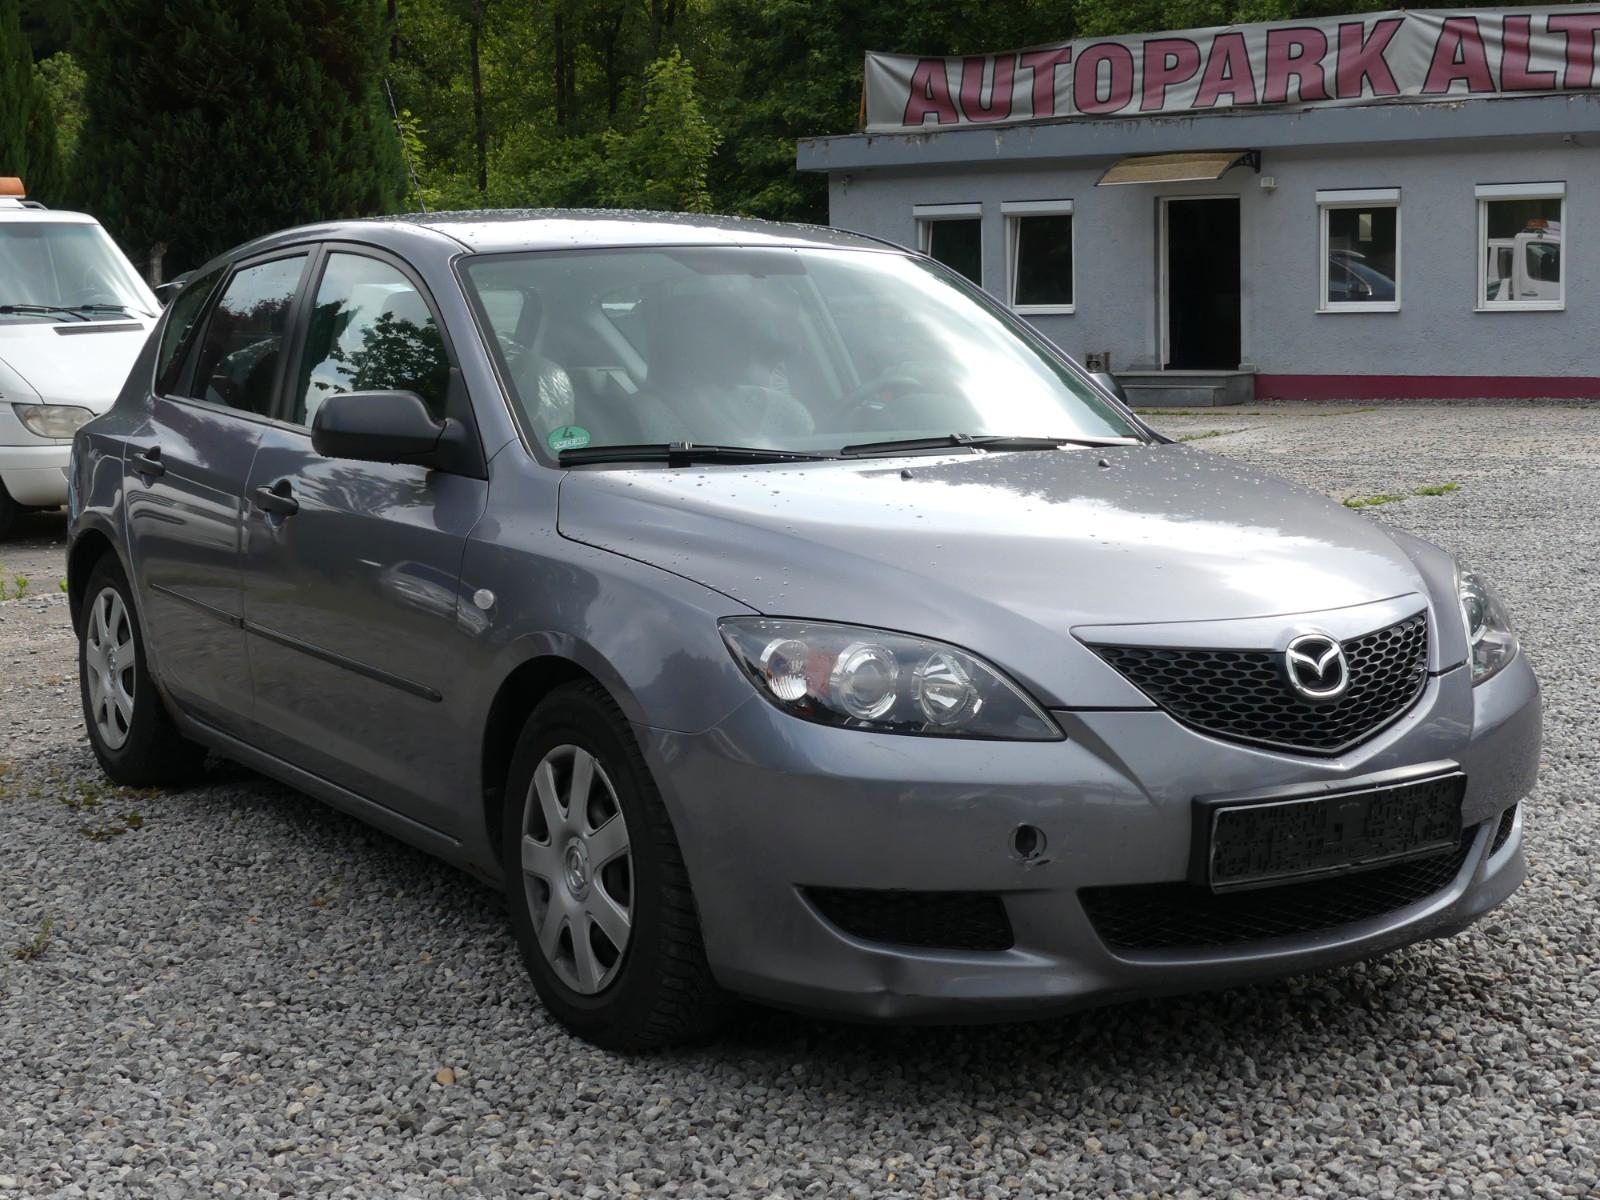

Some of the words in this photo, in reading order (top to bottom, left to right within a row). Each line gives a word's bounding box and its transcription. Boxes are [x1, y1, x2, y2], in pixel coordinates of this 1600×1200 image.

[903, 18, 1405, 126] AUTOPARK
[1420, 12, 1600, 94] ALT
[562, 427, 575, 439] 4
